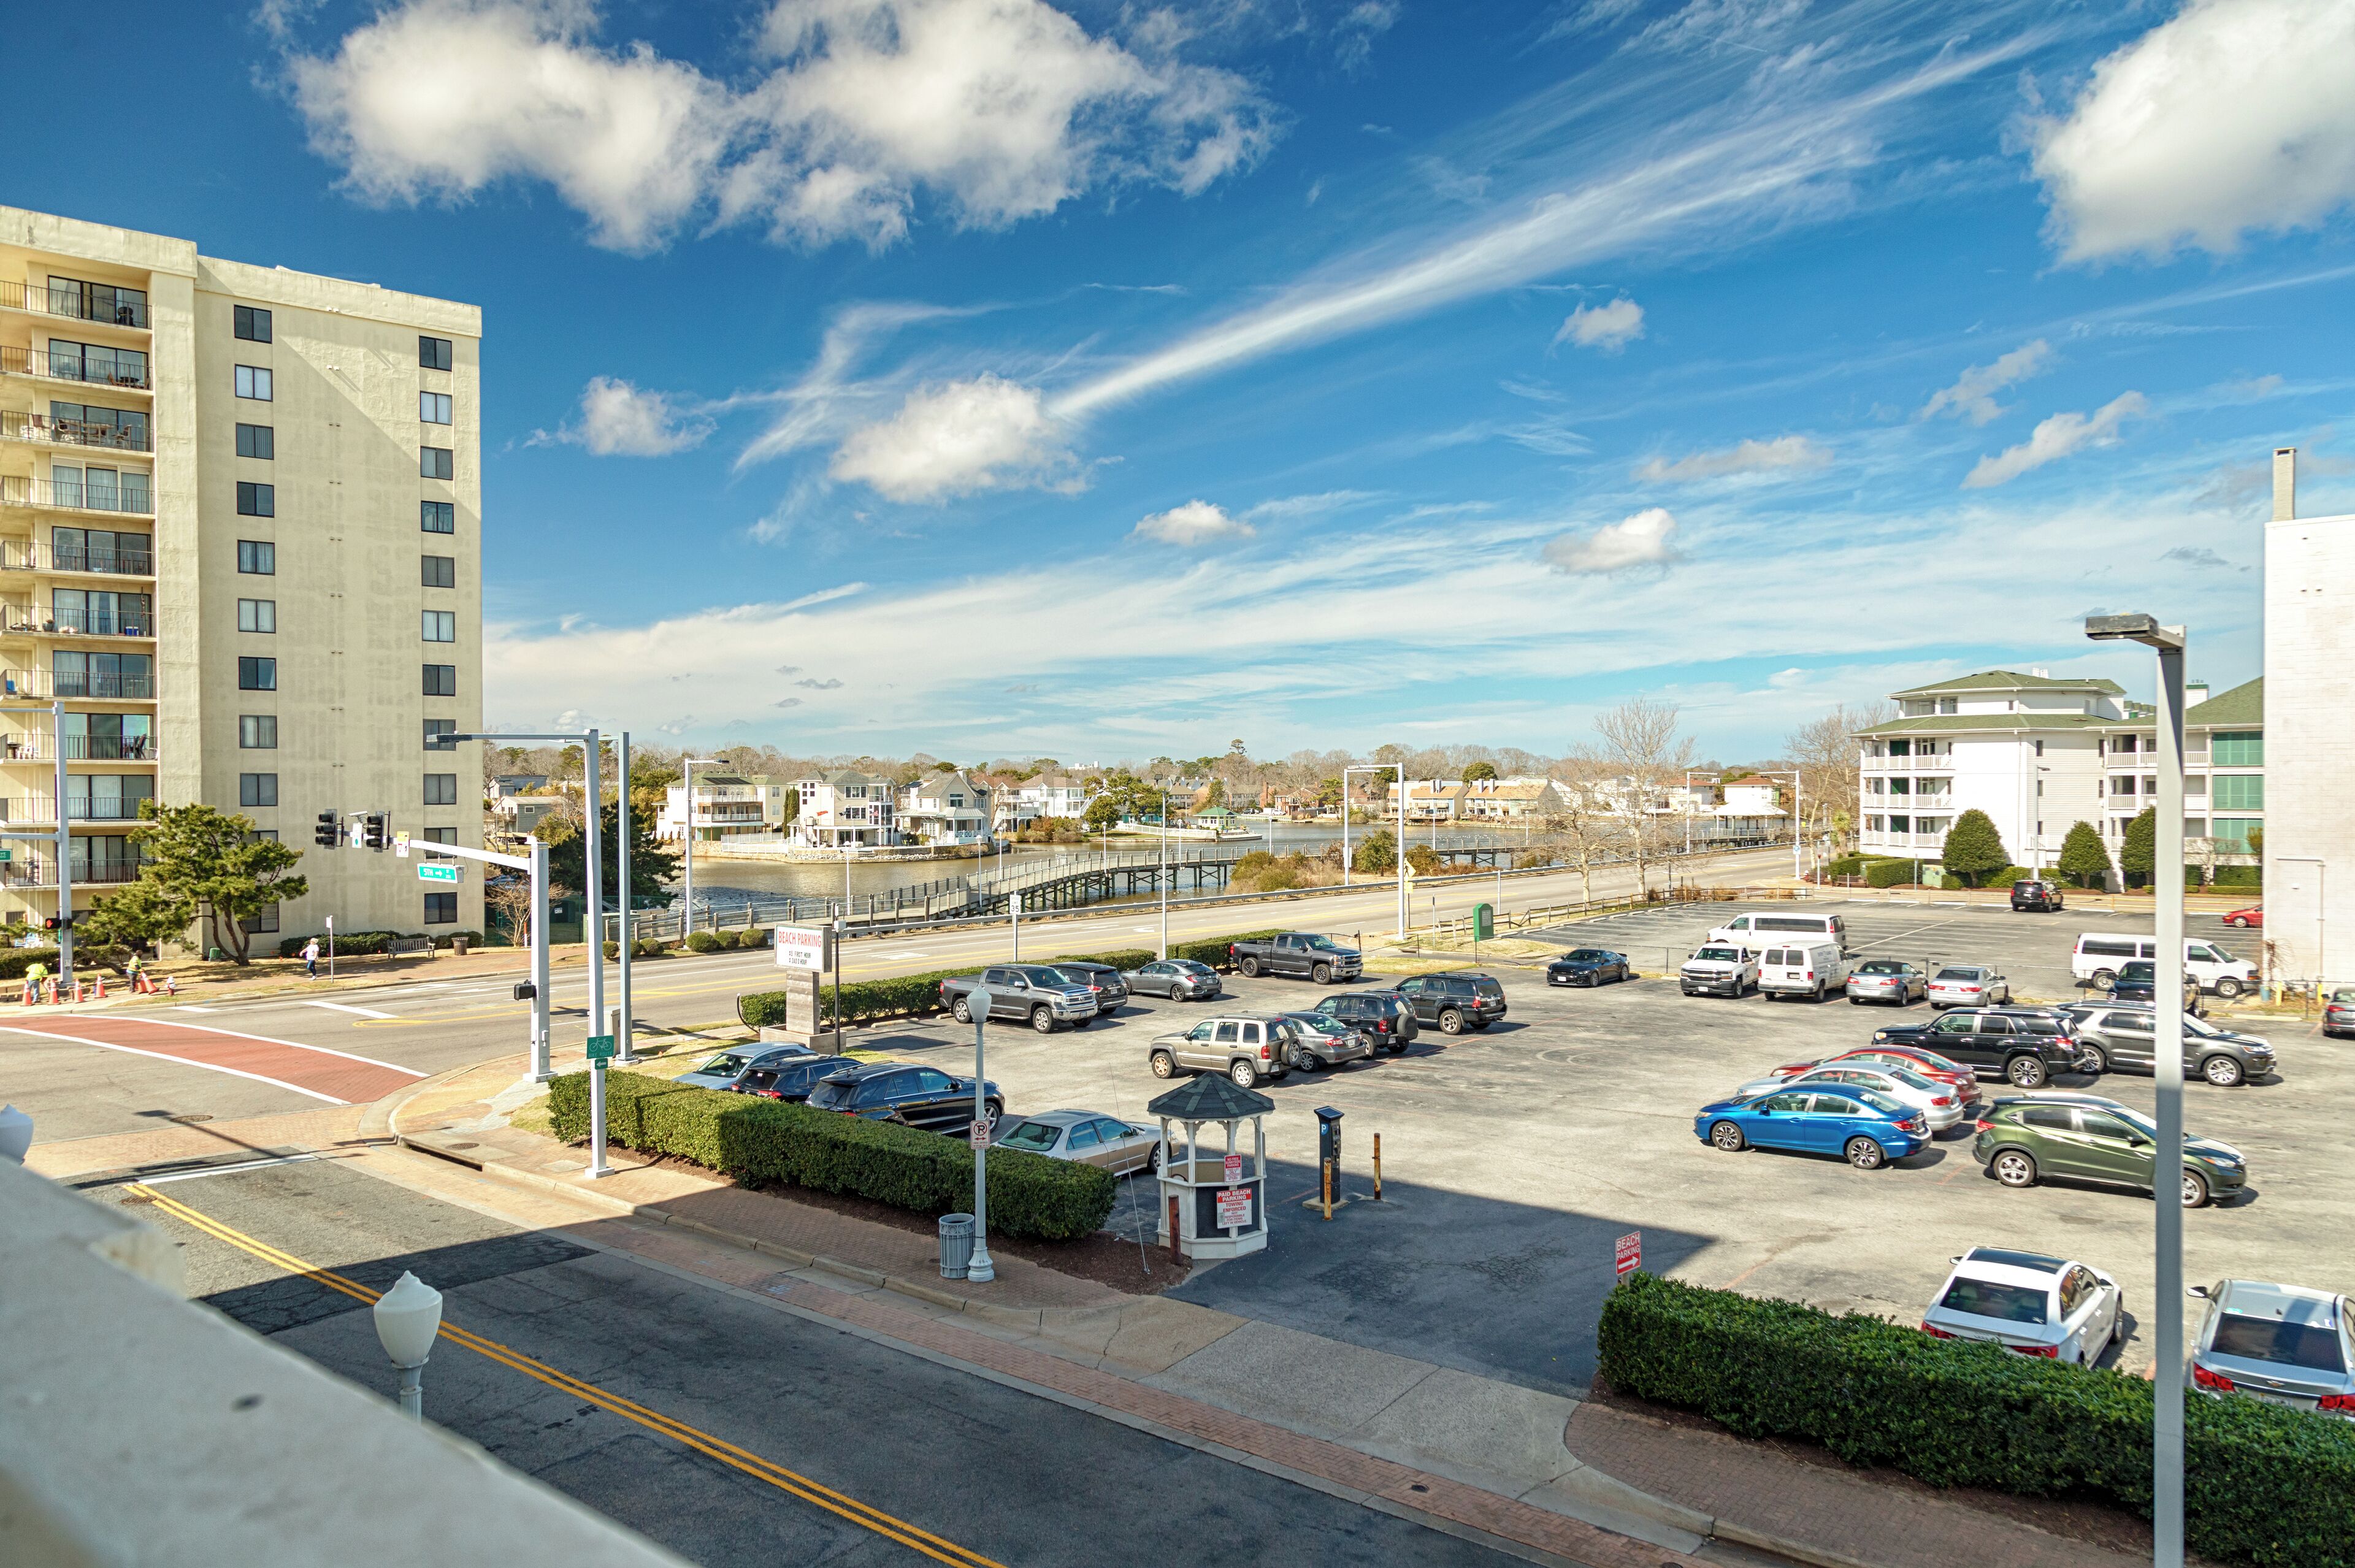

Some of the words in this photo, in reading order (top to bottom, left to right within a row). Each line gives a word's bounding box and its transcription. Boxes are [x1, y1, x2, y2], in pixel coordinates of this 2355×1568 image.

[778, 931, 796, 945] BEACH
[798, 933, 822, 948] PARKING
[1322, 1123, 1327, 1133] P
[1617, 1233, 1640, 1251] BEACH
[1617, 1245, 1640, 1261] PARKING
